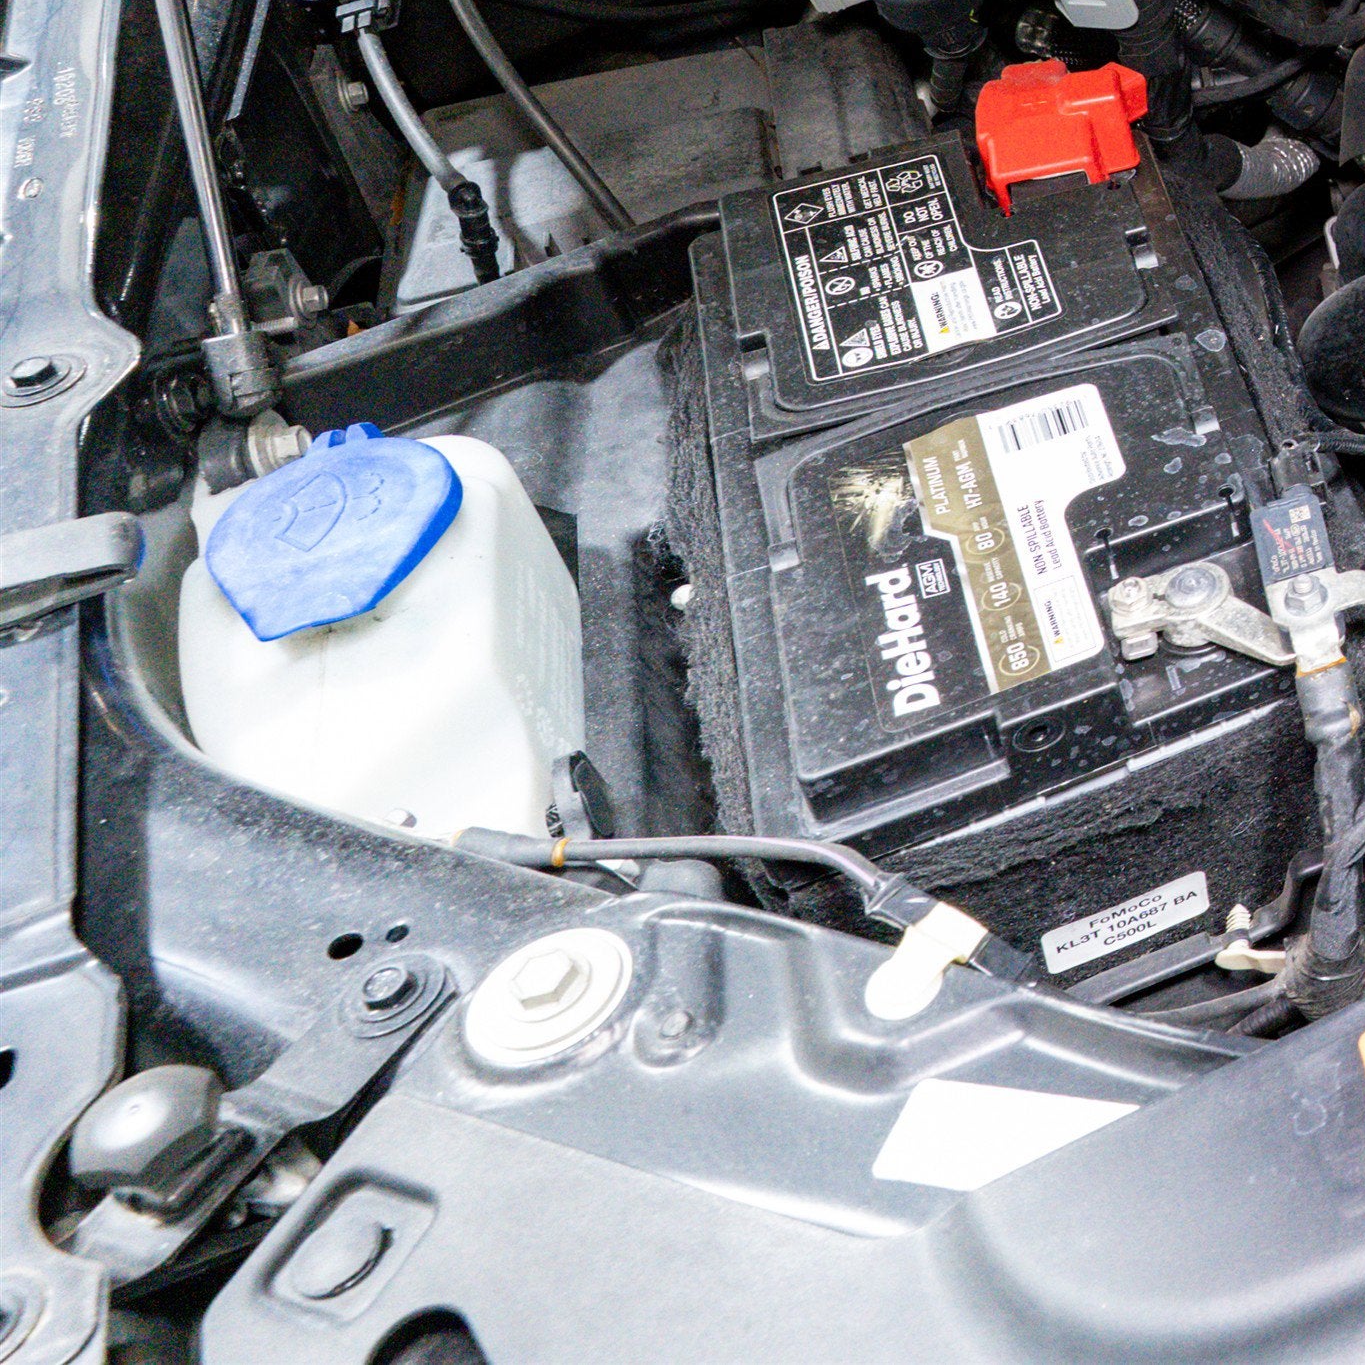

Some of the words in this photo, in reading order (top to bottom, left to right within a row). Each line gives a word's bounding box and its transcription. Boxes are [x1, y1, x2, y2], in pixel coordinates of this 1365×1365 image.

[823, 187, 832, 200] EYES
[858, 176, 868, 197] MEDICAL
[832, 183, 846, 214] IMMEDIATELY
[846, 199, 855, 212] WITH
[863, 199, 871, 208] GET
[872, 194, 881, 206] HELP
[826, 202, 836, 216] FLUSH
[904, 211, 914, 222] DO
[916, 205, 928, 221] NOT
[928, 198, 943, 219] OPEN.
[845, 225, 854, 237] ACID
[859, 228, 869, 244] CAUSE
[870, 226, 884, 253] BLINDNESS
[883, 231, 895, 250] SEVERE
[863, 246, 871, 256] CAN
[910, 246, 921, 260] KEEP
[922, 240, 930, 249] THE
[934, 237, 945, 254] REACH
[1028, 254, 1042, 274] Battery
[1014, 254, 1040, 309] NON-SPILLABLE
[1034, 276, 1044, 287] Acid
[796, 255, 826, 341] DANGER/POISON
[878, 296, 888, 307] CAN
[992, 286, 1002, 302] READ
[1039, 288, 1050, 302] Lead
[881, 309, 893, 325] GASES
[891, 301, 906, 331] BLINDNESS
[931, 292, 948, 326] WARNING:
[907, 318, 919, 337] INJURY.
[873, 340, 886, 358] SHIELD
[885, 326, 901, 354] EXPLOSIVE
[899, 332, 911, 350] CAUSE
[913, 338, 922, 347] OR
[923, 456, 950, 513] PLATINUM
[956, 460, 982, 508] H7-AGM
[1033, 500, 1051, 528] Battery
[975, 532, 994, 549] 80
[1041, 531, 1053, 546] Acid
[991, 557, 1003, 578] CAPACITY
[1048, 549, 1061, 568] Lead
[920, 564, 937, 593] AGM
[933, 562, 944, 589] TECHNOLOGY
[989, 582, 1011, 606] 140
[1004, 616, 1016, 639] CRANKING
[864, 567, 941, 715] DieHard
[1006, 642, 1029, 669] 850
[1089, 893, 1161, 928] FoMoCo
[1056, 930, 1100, 952] KL3T
[1108, 902, 1166, 931] 10A687
[1173, 890, 1196, 904] BA
[1103, 919, 1155, 945] C500L
